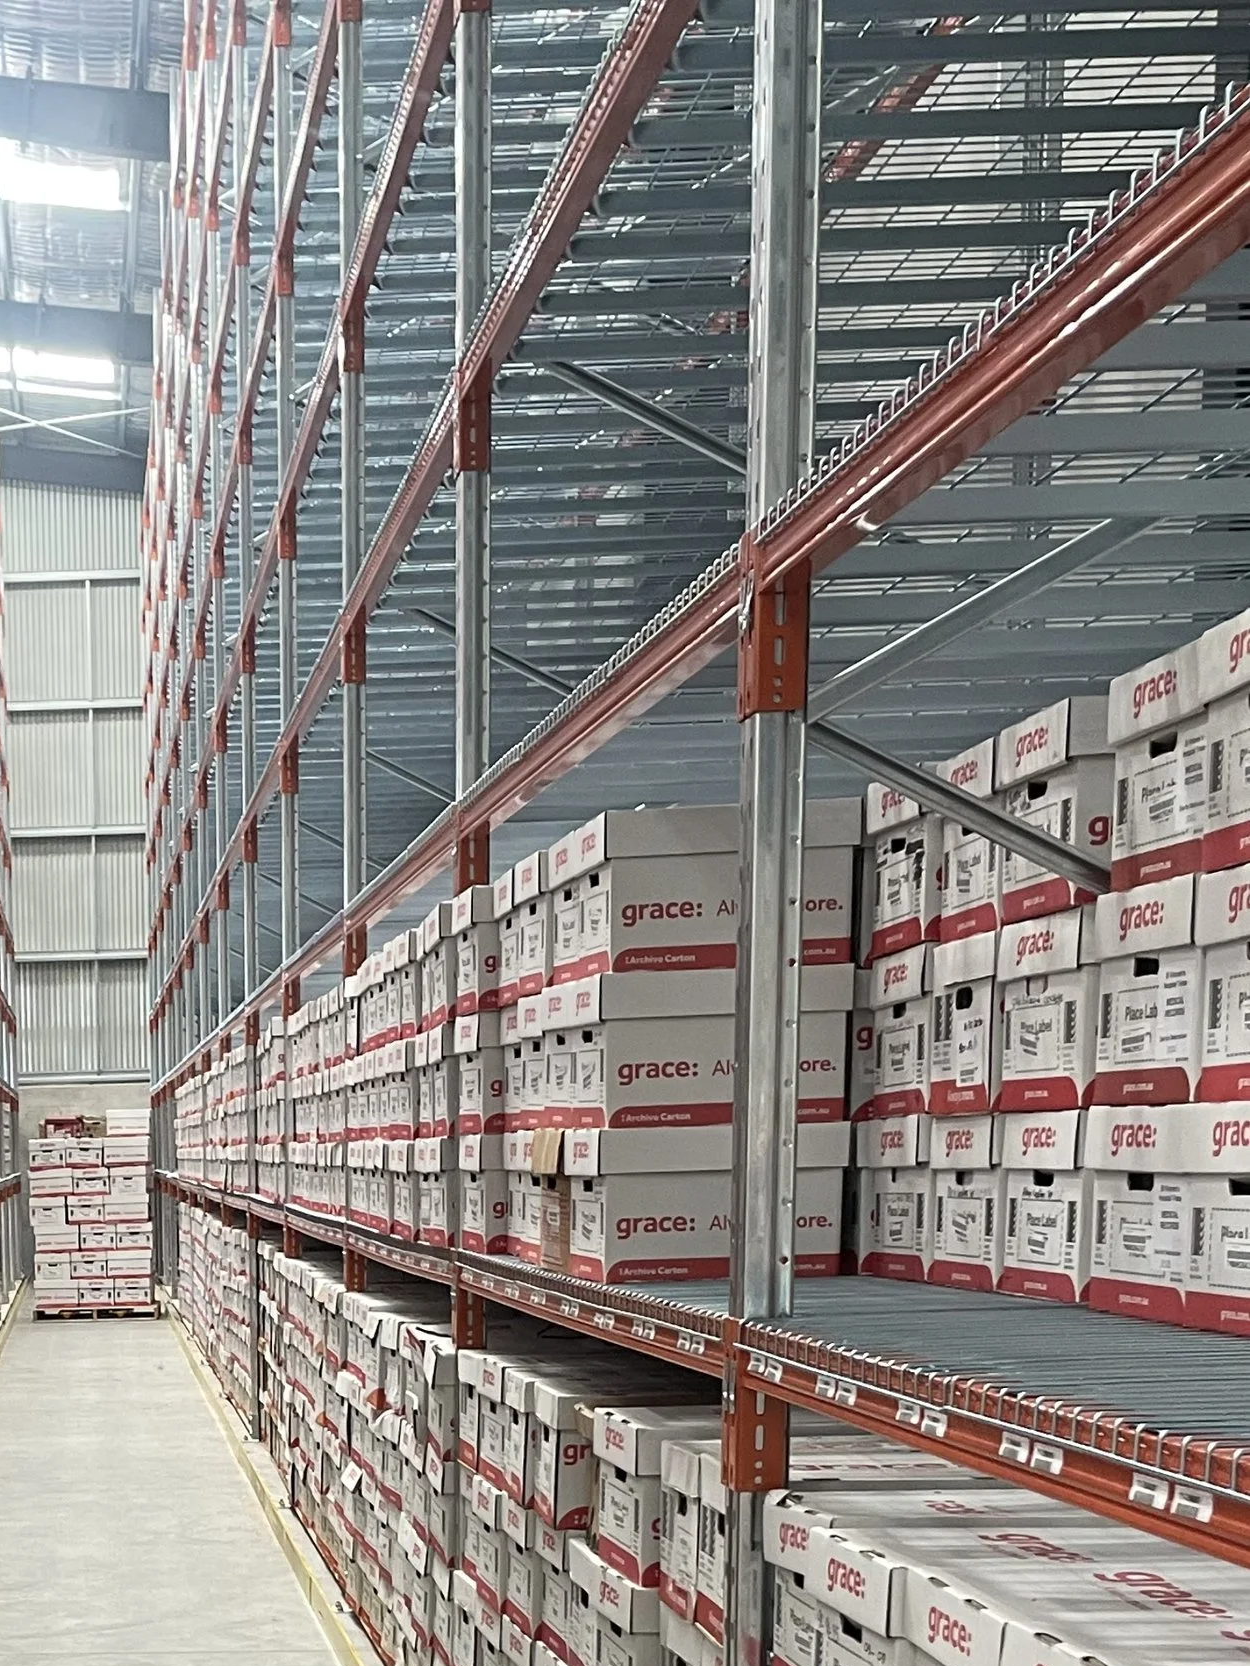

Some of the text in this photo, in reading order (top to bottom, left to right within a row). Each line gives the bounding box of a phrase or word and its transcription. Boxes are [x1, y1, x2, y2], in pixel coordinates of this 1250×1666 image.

[1132, 669, 1178, 720] grace:
[1014, 725, 1049, 767] grace:
[621, 901, 704, 929] grace:
[1118, 900, 1165, 942] grace:
[1015, 929, 1055, 967] grace:
[617, 1060, 700, 1087] grace:
[1021, 1124, 1058, 1157] grace:
[1110, 1121, 1158, 1158] grace:
[1211, 1118, 1250, 1158] grac
[615, 1215, 697, 1241] grace:
[826, 1555, 866, 1599] grace:
[927, 1605, 973, 1658] grace:
